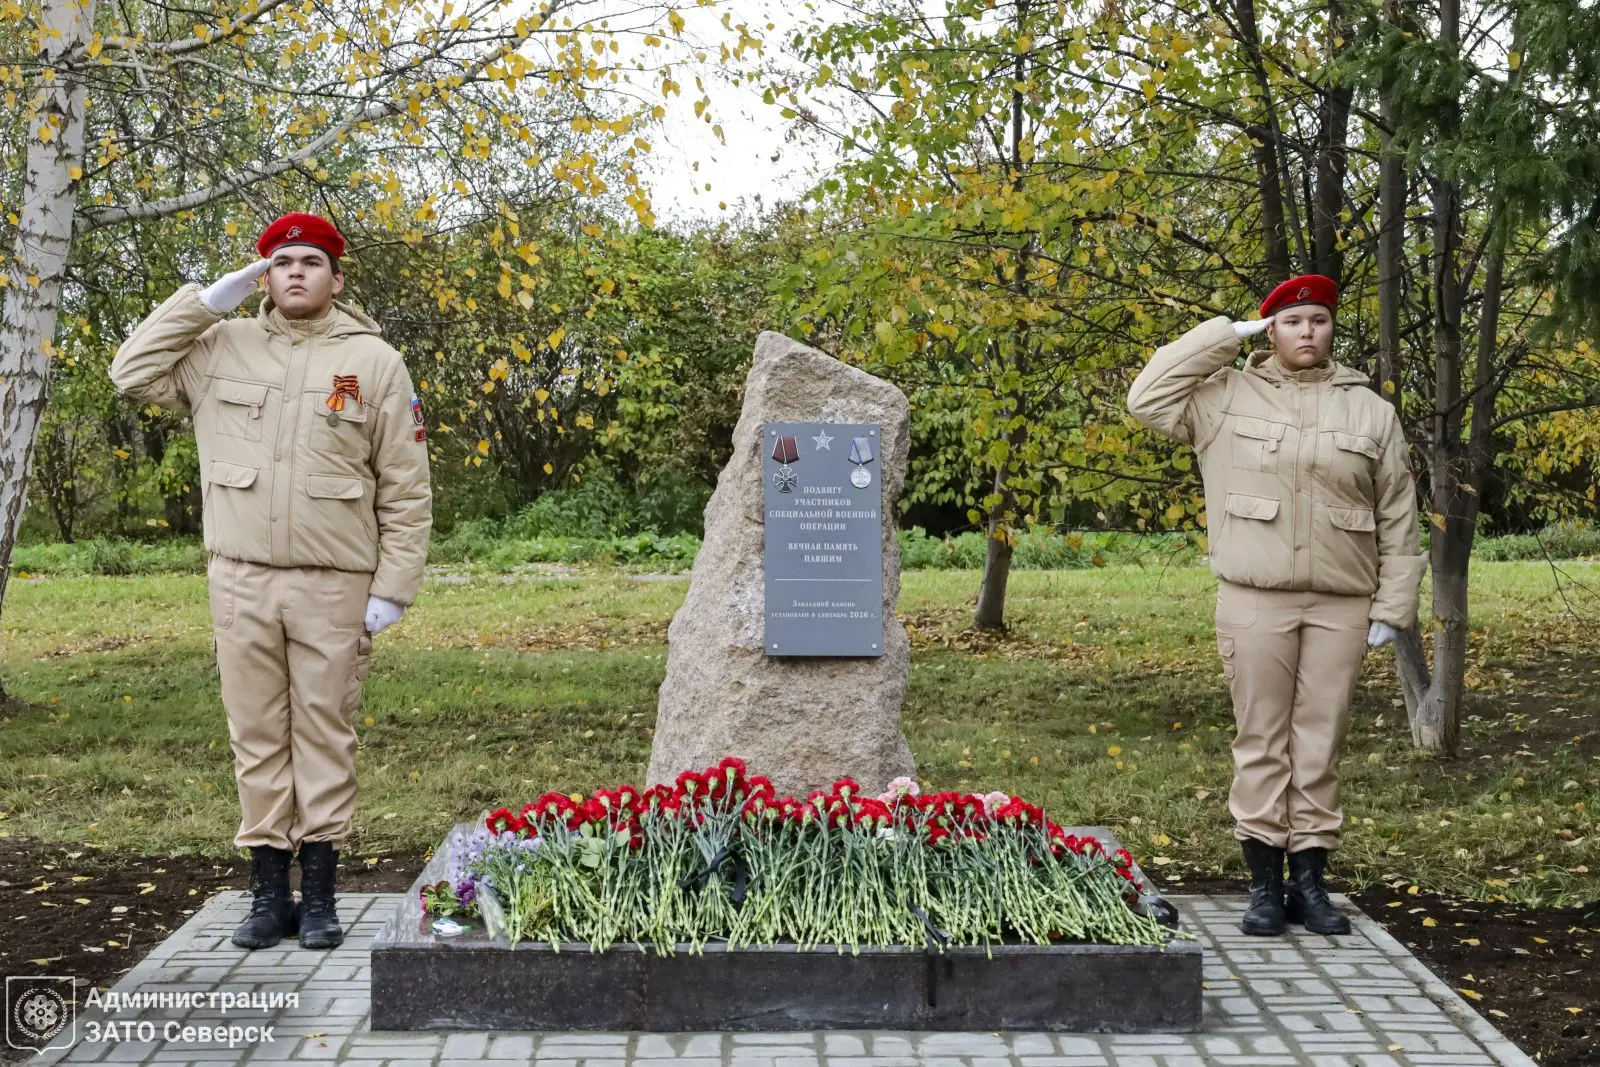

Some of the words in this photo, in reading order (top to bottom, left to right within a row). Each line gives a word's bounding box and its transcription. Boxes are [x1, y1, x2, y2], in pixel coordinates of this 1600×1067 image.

[803, 486, 842, 494] ПОДВИГУ
[794, 498, 851, 506] УЧАСТНИКОВ
[769, 509, 833, 519] СПЕЦИАЛЬНОЙ
[835, 509, 876, 519] ВОЕННОЙ
[800, 522, 846, 531] ОПЕРАЦИИ
[788, 542, 821, 550] ВЕЧНАЯ
[823, 542, 858, 551] ПАМЯТЬ
[804, 555, 842, 563] ПАВШИМ
